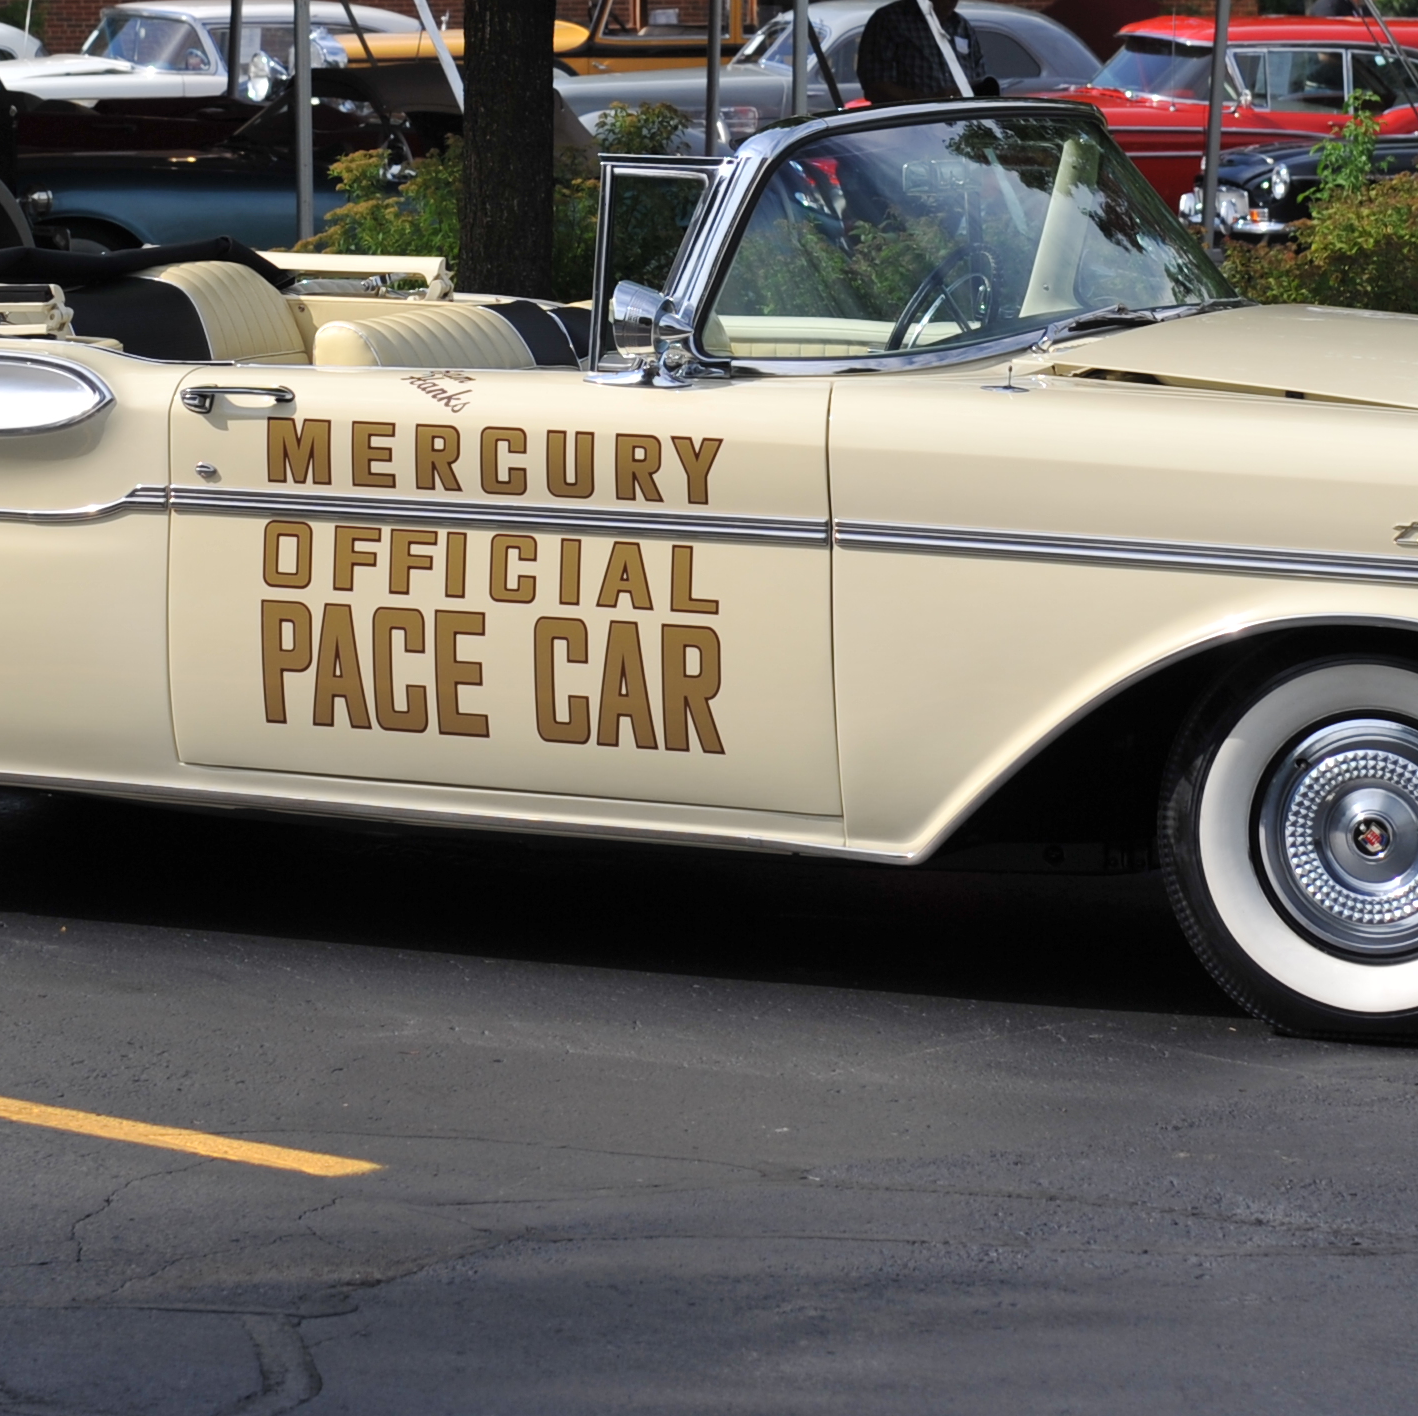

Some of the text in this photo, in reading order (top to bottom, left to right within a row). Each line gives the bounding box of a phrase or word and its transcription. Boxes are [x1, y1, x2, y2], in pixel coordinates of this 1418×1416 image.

[266, 416, 724, 506] MERCURY
[262, 519, 720, 616] OFFICIAL
[260, 599, 727, 756] PACE CAR
